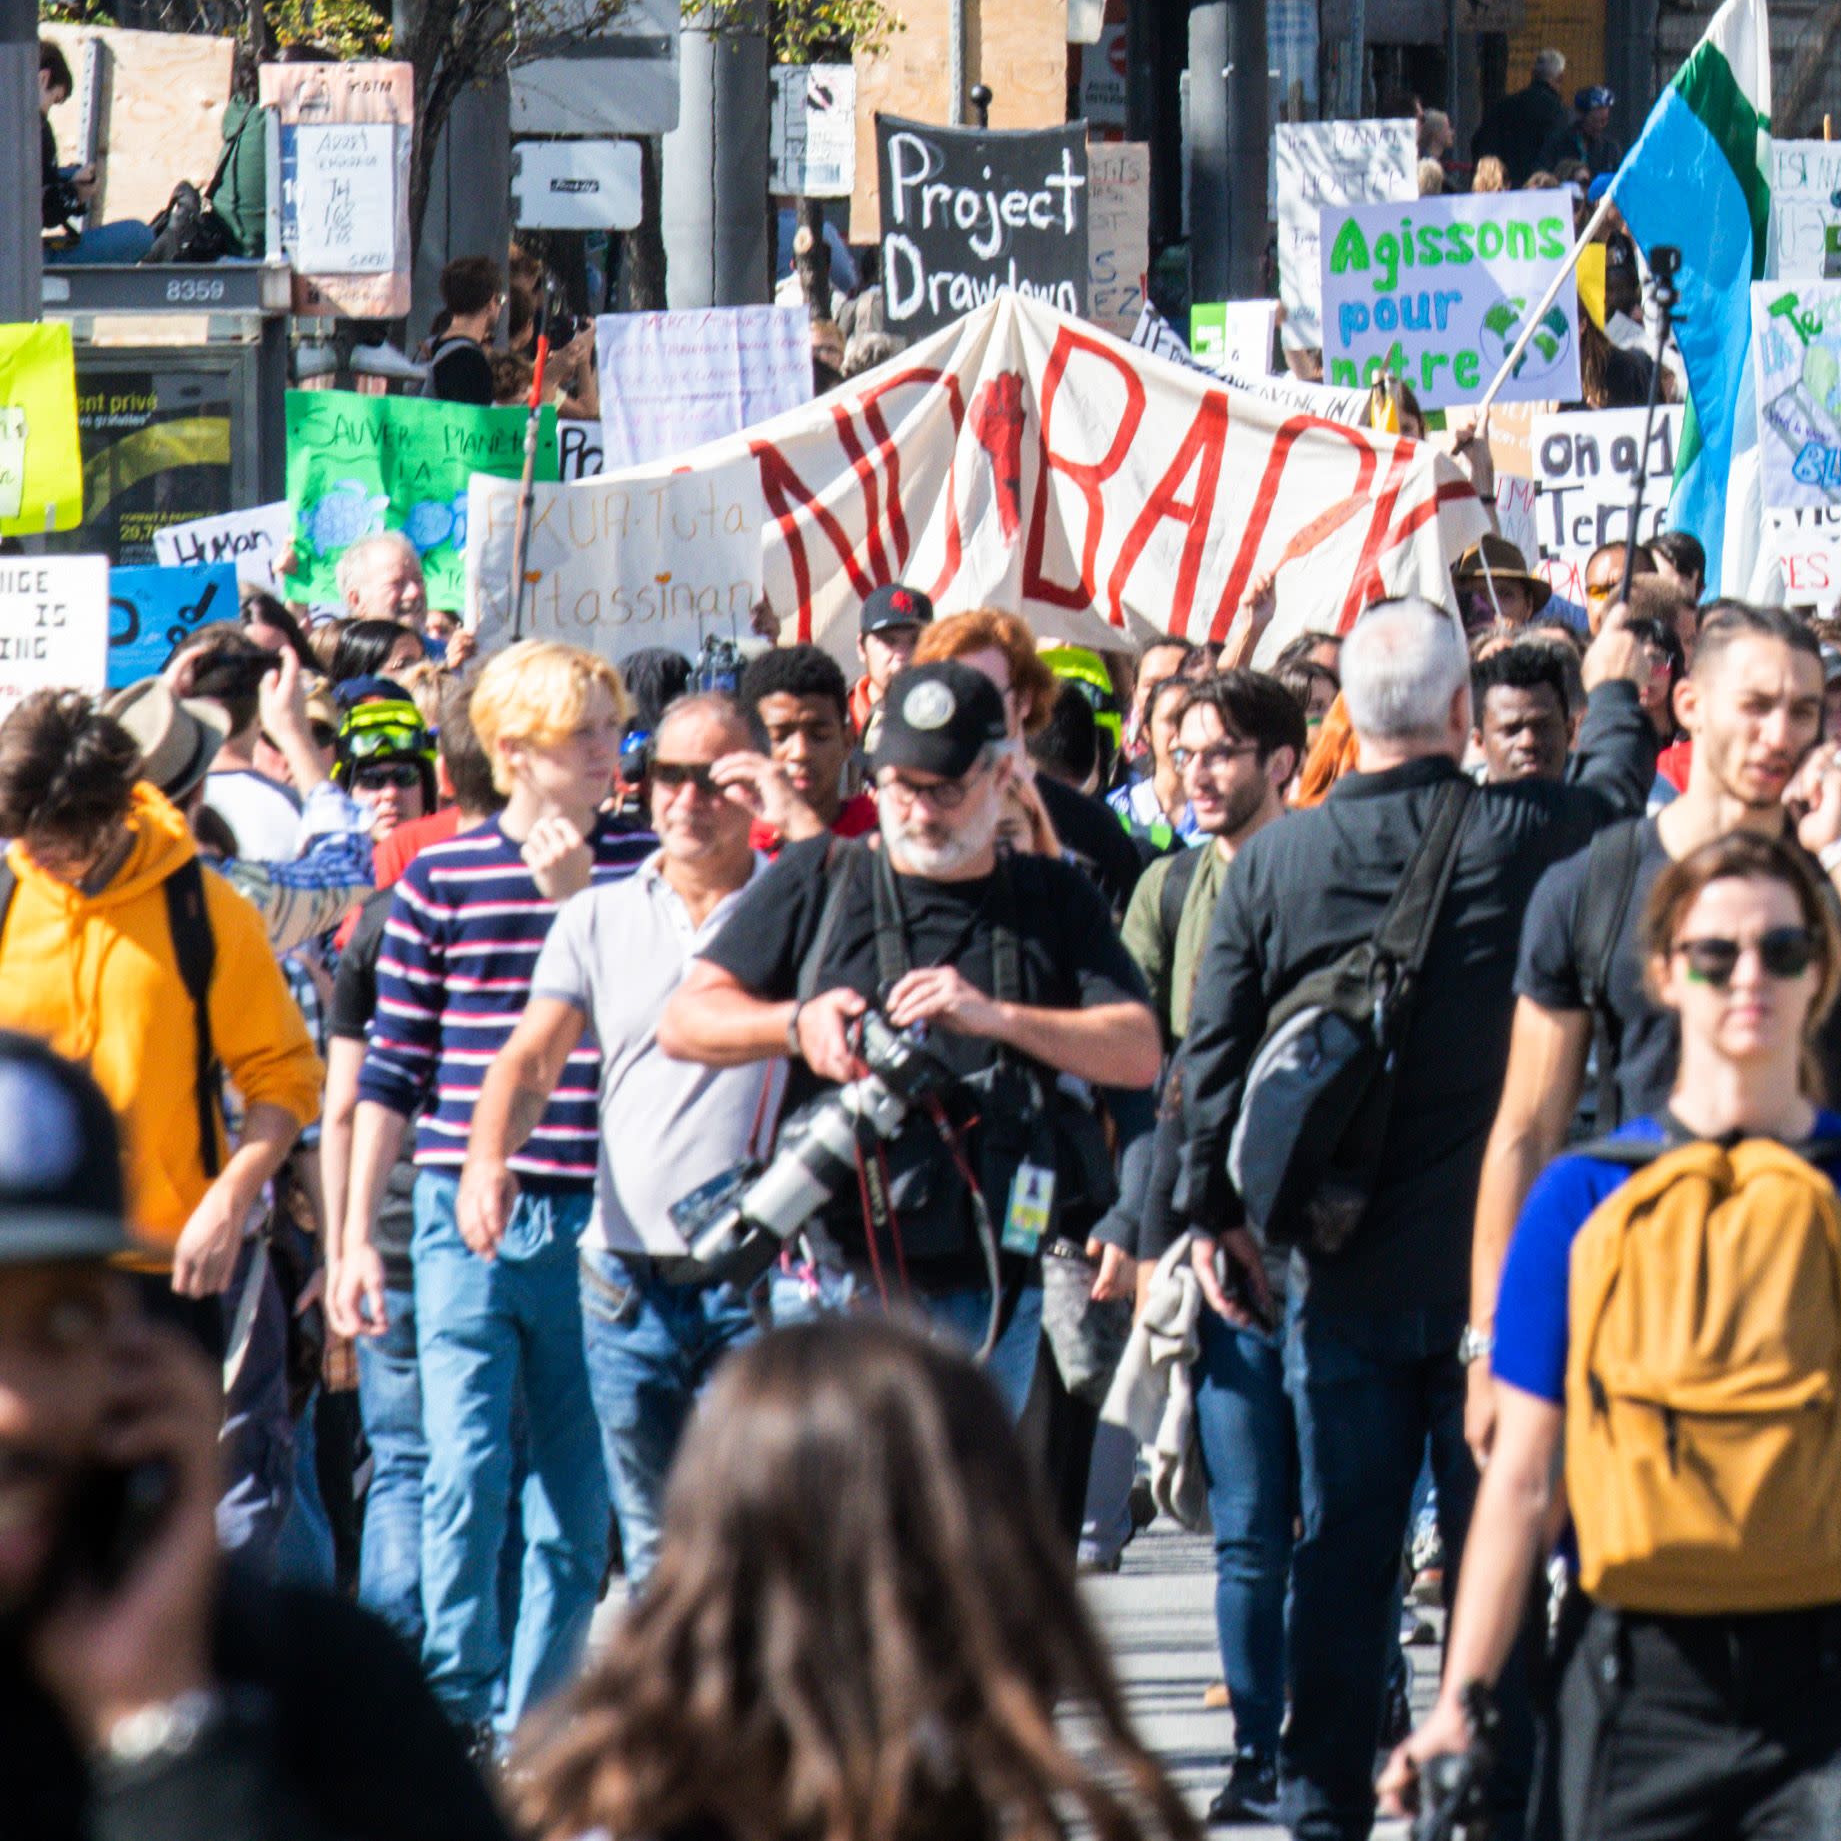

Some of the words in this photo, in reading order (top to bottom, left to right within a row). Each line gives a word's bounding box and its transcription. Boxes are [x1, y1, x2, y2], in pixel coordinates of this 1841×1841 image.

[888, 133, 1086, 259] Project
[1329, 215, 1565, 292] Agissons
[165, 278, 225, 302] 8359
[1339, 291, 1462, 348] pour
[1331, 341, 1480, 392] notre
[110, 392, 158, 416] privé
[1540, 432, 1600, 477] On
[1610, 438, 1642, 475] a
[36, 604, 66, 628] IS
